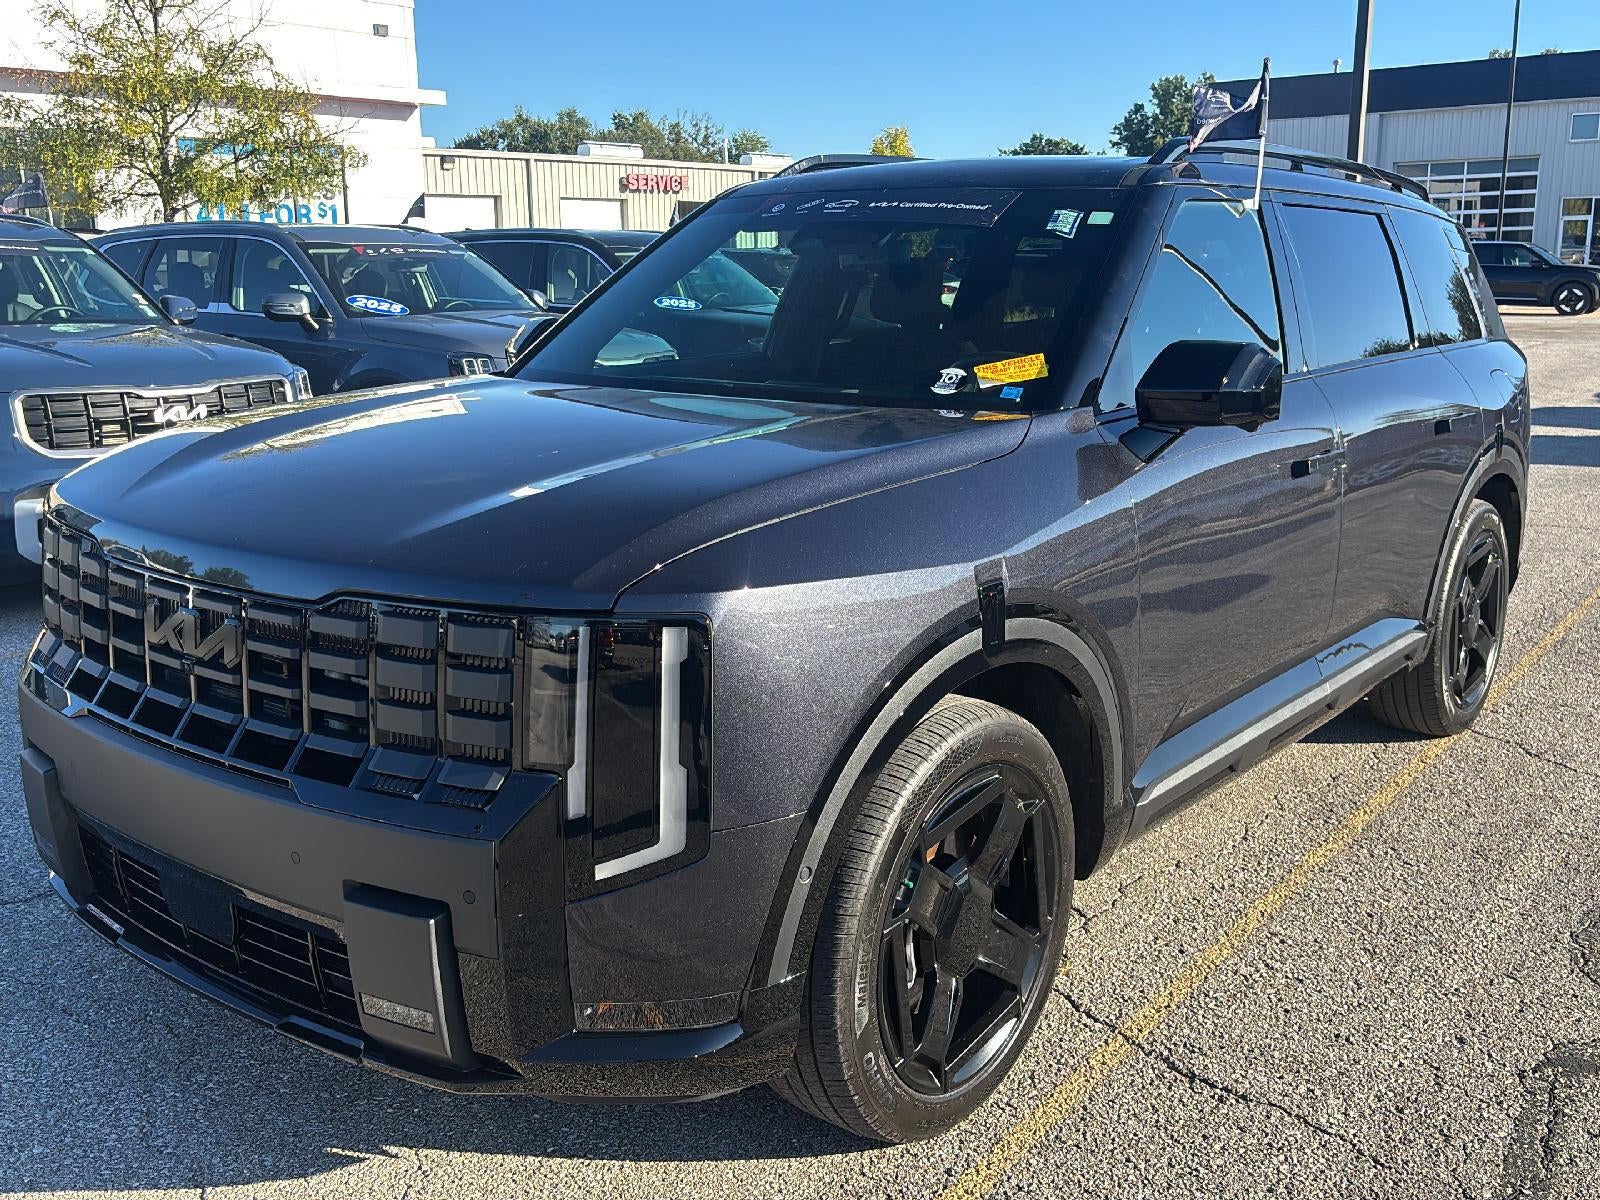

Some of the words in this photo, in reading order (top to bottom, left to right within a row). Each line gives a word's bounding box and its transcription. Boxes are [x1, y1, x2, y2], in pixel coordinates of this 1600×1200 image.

[627, 174, 689, 192] SERVICE
[317, 201, 338, 225] $1
[354, 297, 402, 313] 2025
[661, 298, 696, 309] 2025
[976, 363, 999, 374] THIS
[1001, 355, 1042, 368] VEHICLE
[153, 403, 208, 423] KIA
[144, 600, 243, 669] KIA
